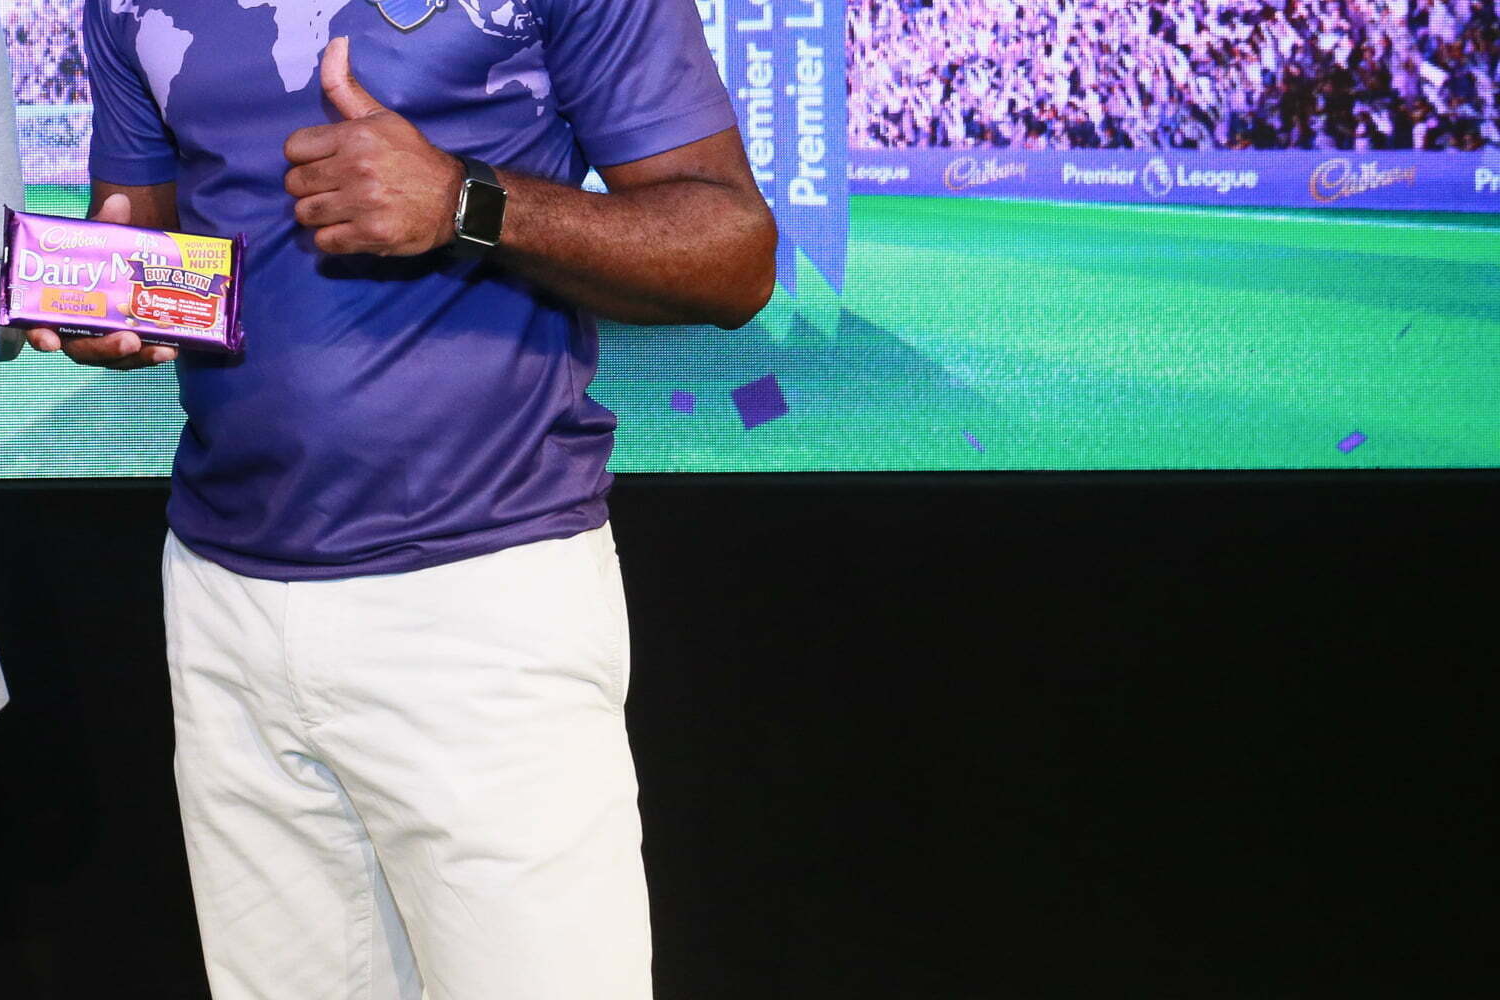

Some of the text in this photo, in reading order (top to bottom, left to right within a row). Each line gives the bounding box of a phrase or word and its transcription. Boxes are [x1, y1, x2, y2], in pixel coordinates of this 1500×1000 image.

[738, 42, 775, 198] remier
[785, 39, 828, 206] Premier
[1062, 162, 1259, 193] Premier League
[1308, 158, 1417, 203] Cadbury
[39, 226, 108, 252] Cadbury
[187, 249, 227, 259] WHOLE
[19, 248, 107, 292] Dairy
[144, 268, 171, 282] BUY
[172, 270, 184, 284] &
[184, 272, 211, 291] WIN
[190, 260, 224, 269] NUTS!
